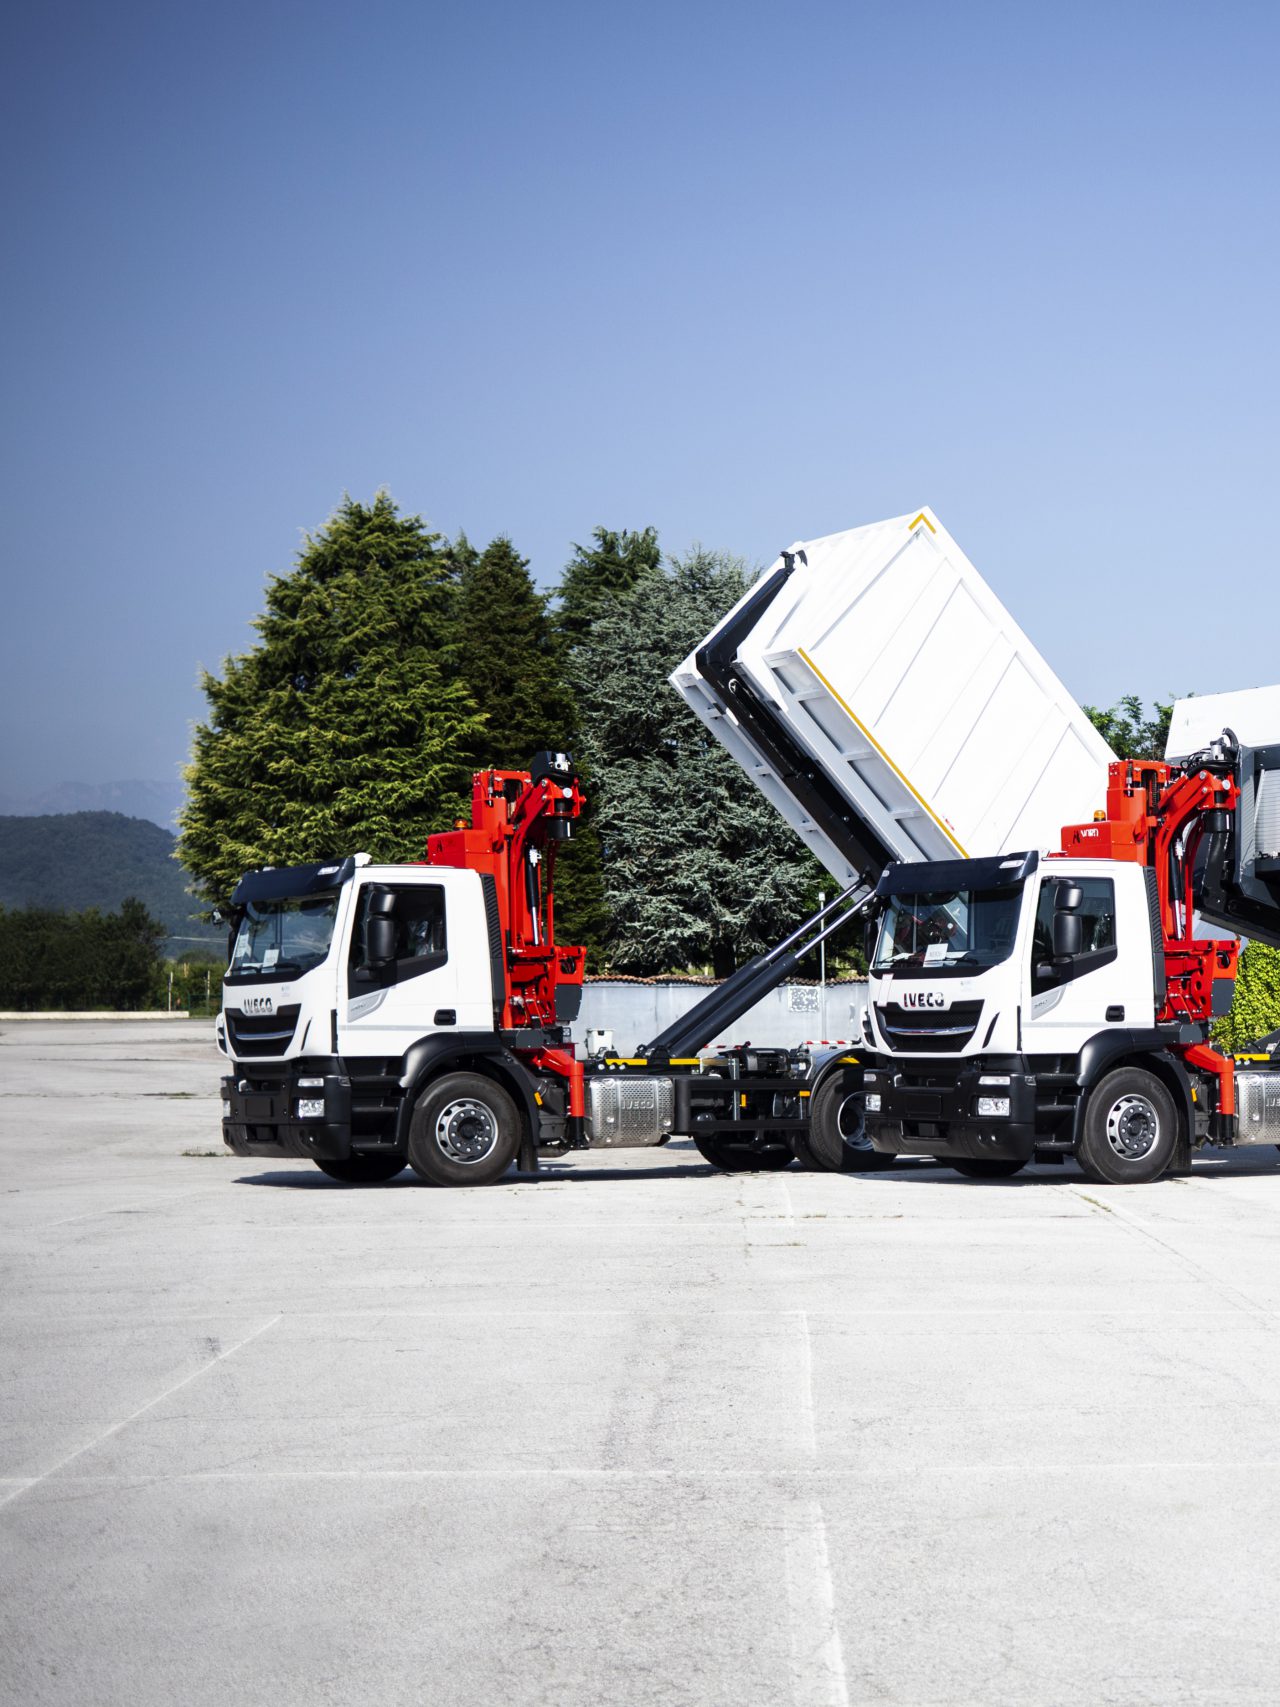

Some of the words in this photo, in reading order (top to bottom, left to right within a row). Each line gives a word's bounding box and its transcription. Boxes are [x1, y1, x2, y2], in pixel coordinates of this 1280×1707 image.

[243, 997, 273, 1014] IVECO
[904, 992, 945, 1008] IVECO
[621, 1100, 654, 1110] IVECO
